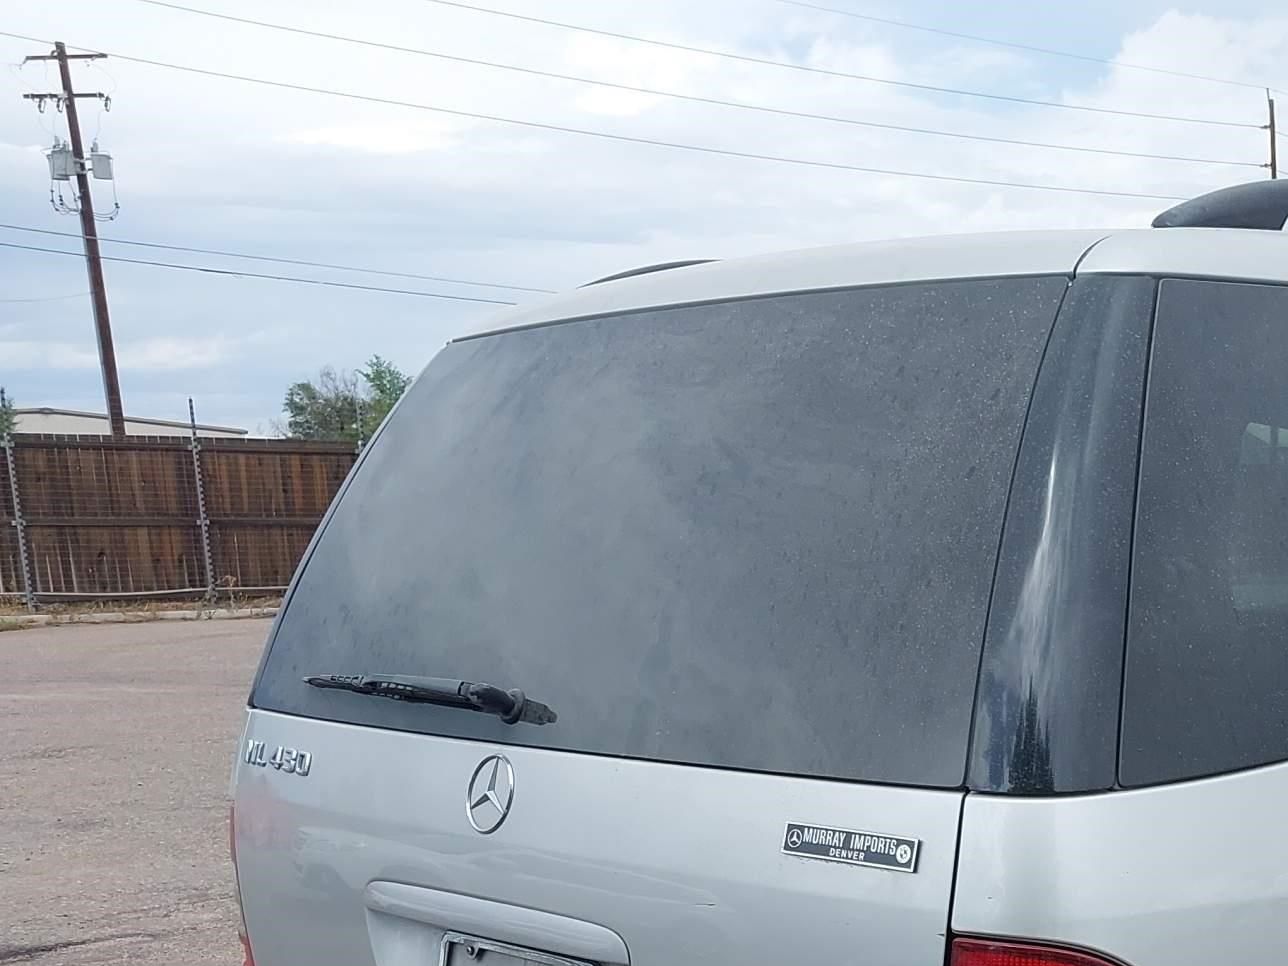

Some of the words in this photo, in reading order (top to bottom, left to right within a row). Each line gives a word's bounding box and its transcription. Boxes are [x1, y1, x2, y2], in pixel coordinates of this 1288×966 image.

[269, 745, 312, 776] 430
[802, 827, 847, 848] MURRAY
[850, 834, 898, 856] IMPORTS
[829, 847, 865, 861] DENVER
